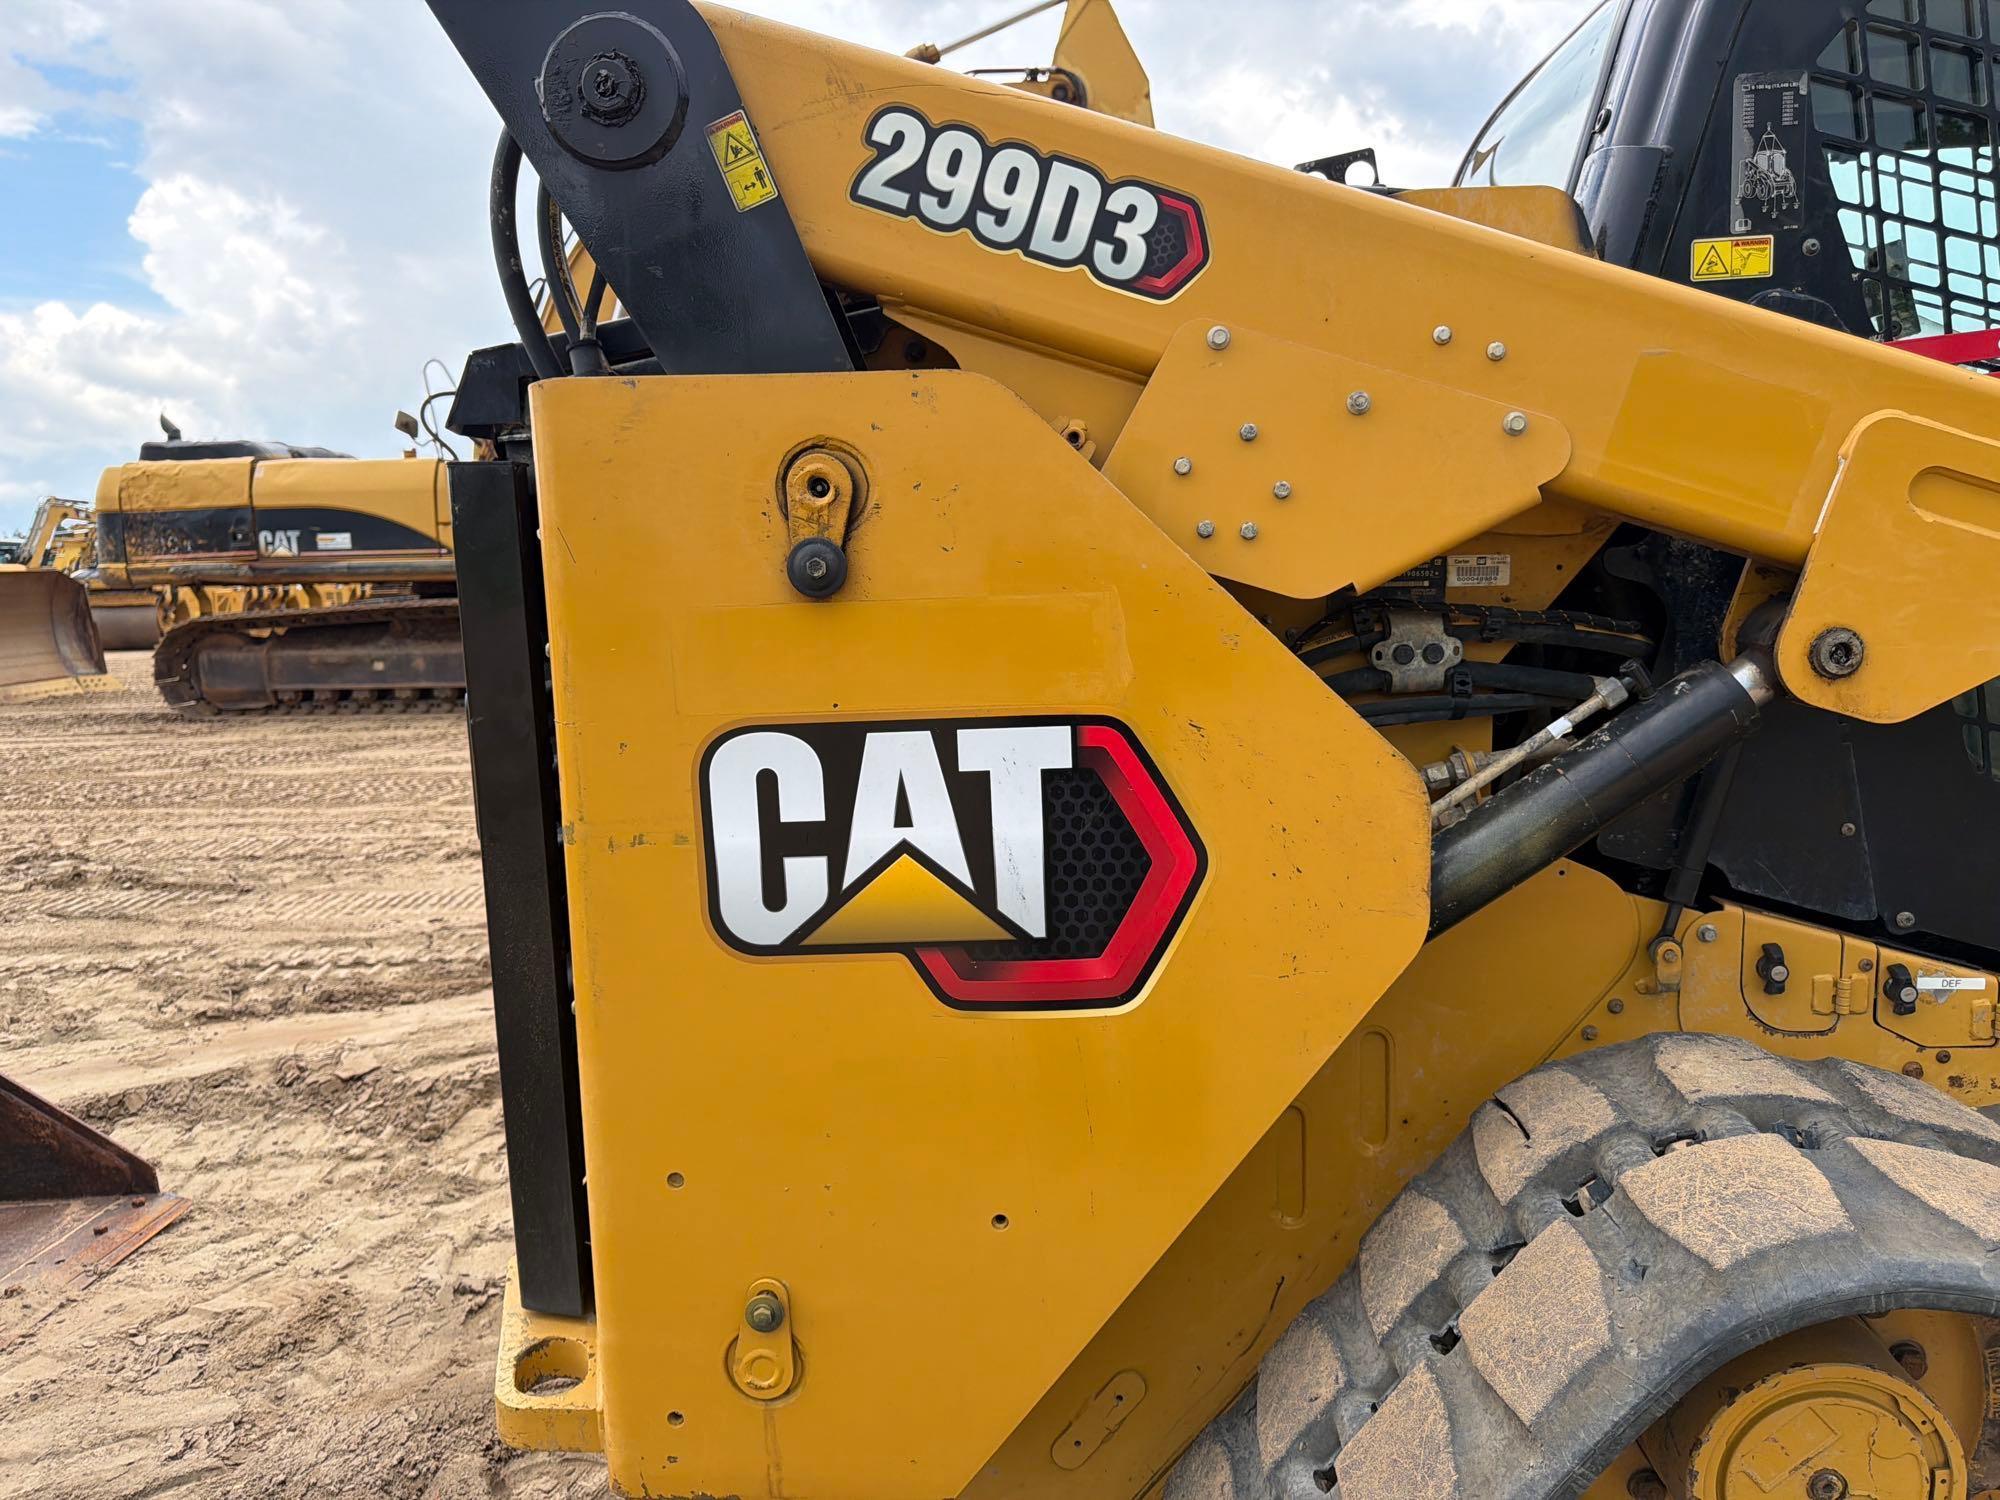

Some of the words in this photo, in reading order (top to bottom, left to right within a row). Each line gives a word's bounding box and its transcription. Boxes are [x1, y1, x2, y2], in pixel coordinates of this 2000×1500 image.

[716, 114, 742, 132] WARNING
[858, 112, 1158, 280] 299D3
[259, 529, 301, 558] CAT
[709, 726, 1073, 945] CAT
[1941, 979, 1962, 988] DEF
